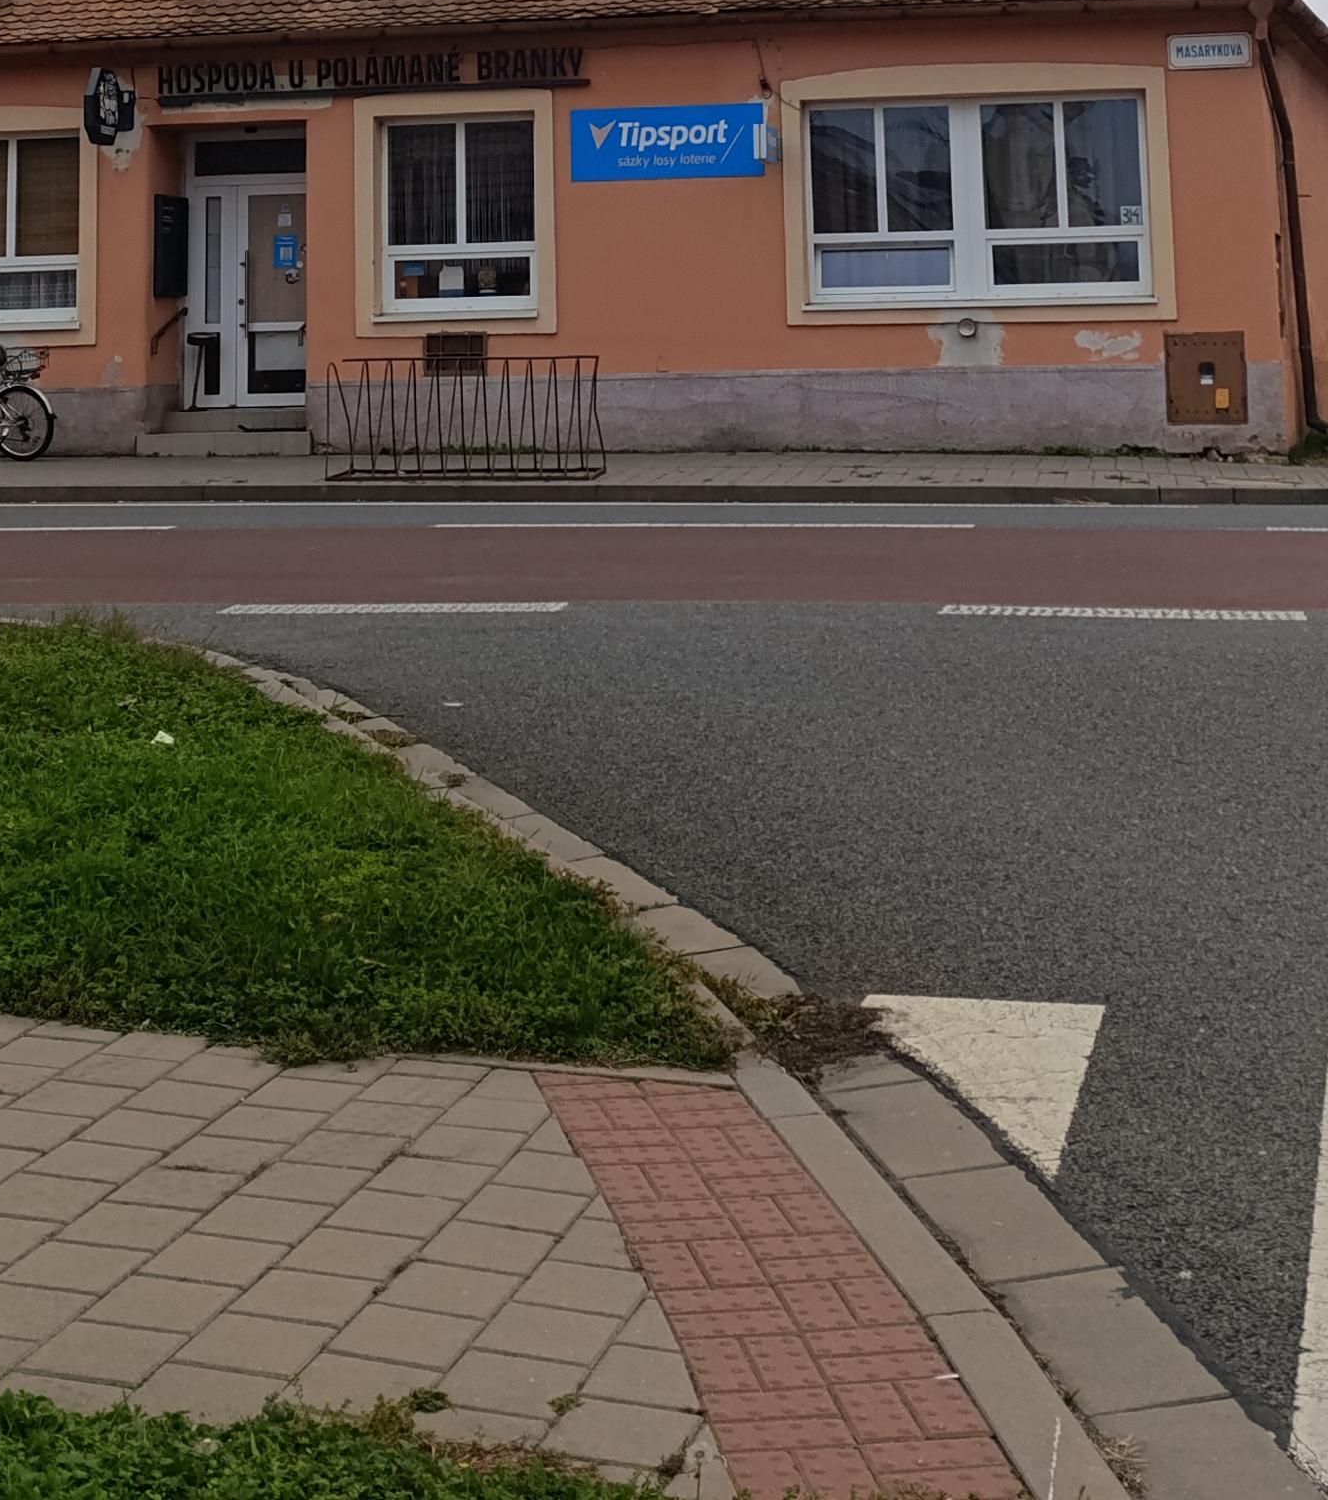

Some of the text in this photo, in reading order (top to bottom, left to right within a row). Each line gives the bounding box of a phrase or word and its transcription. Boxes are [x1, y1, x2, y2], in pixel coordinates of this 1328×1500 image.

[1176, 43, 1244, 59] MASARYKOVA
[158, 45, 584, 94] HOSPODA U POLÁMANÉ BRANKY
[618, 119, 728, 152] Tipsport
[618, 152, 717, 169] sázky losy loterie
